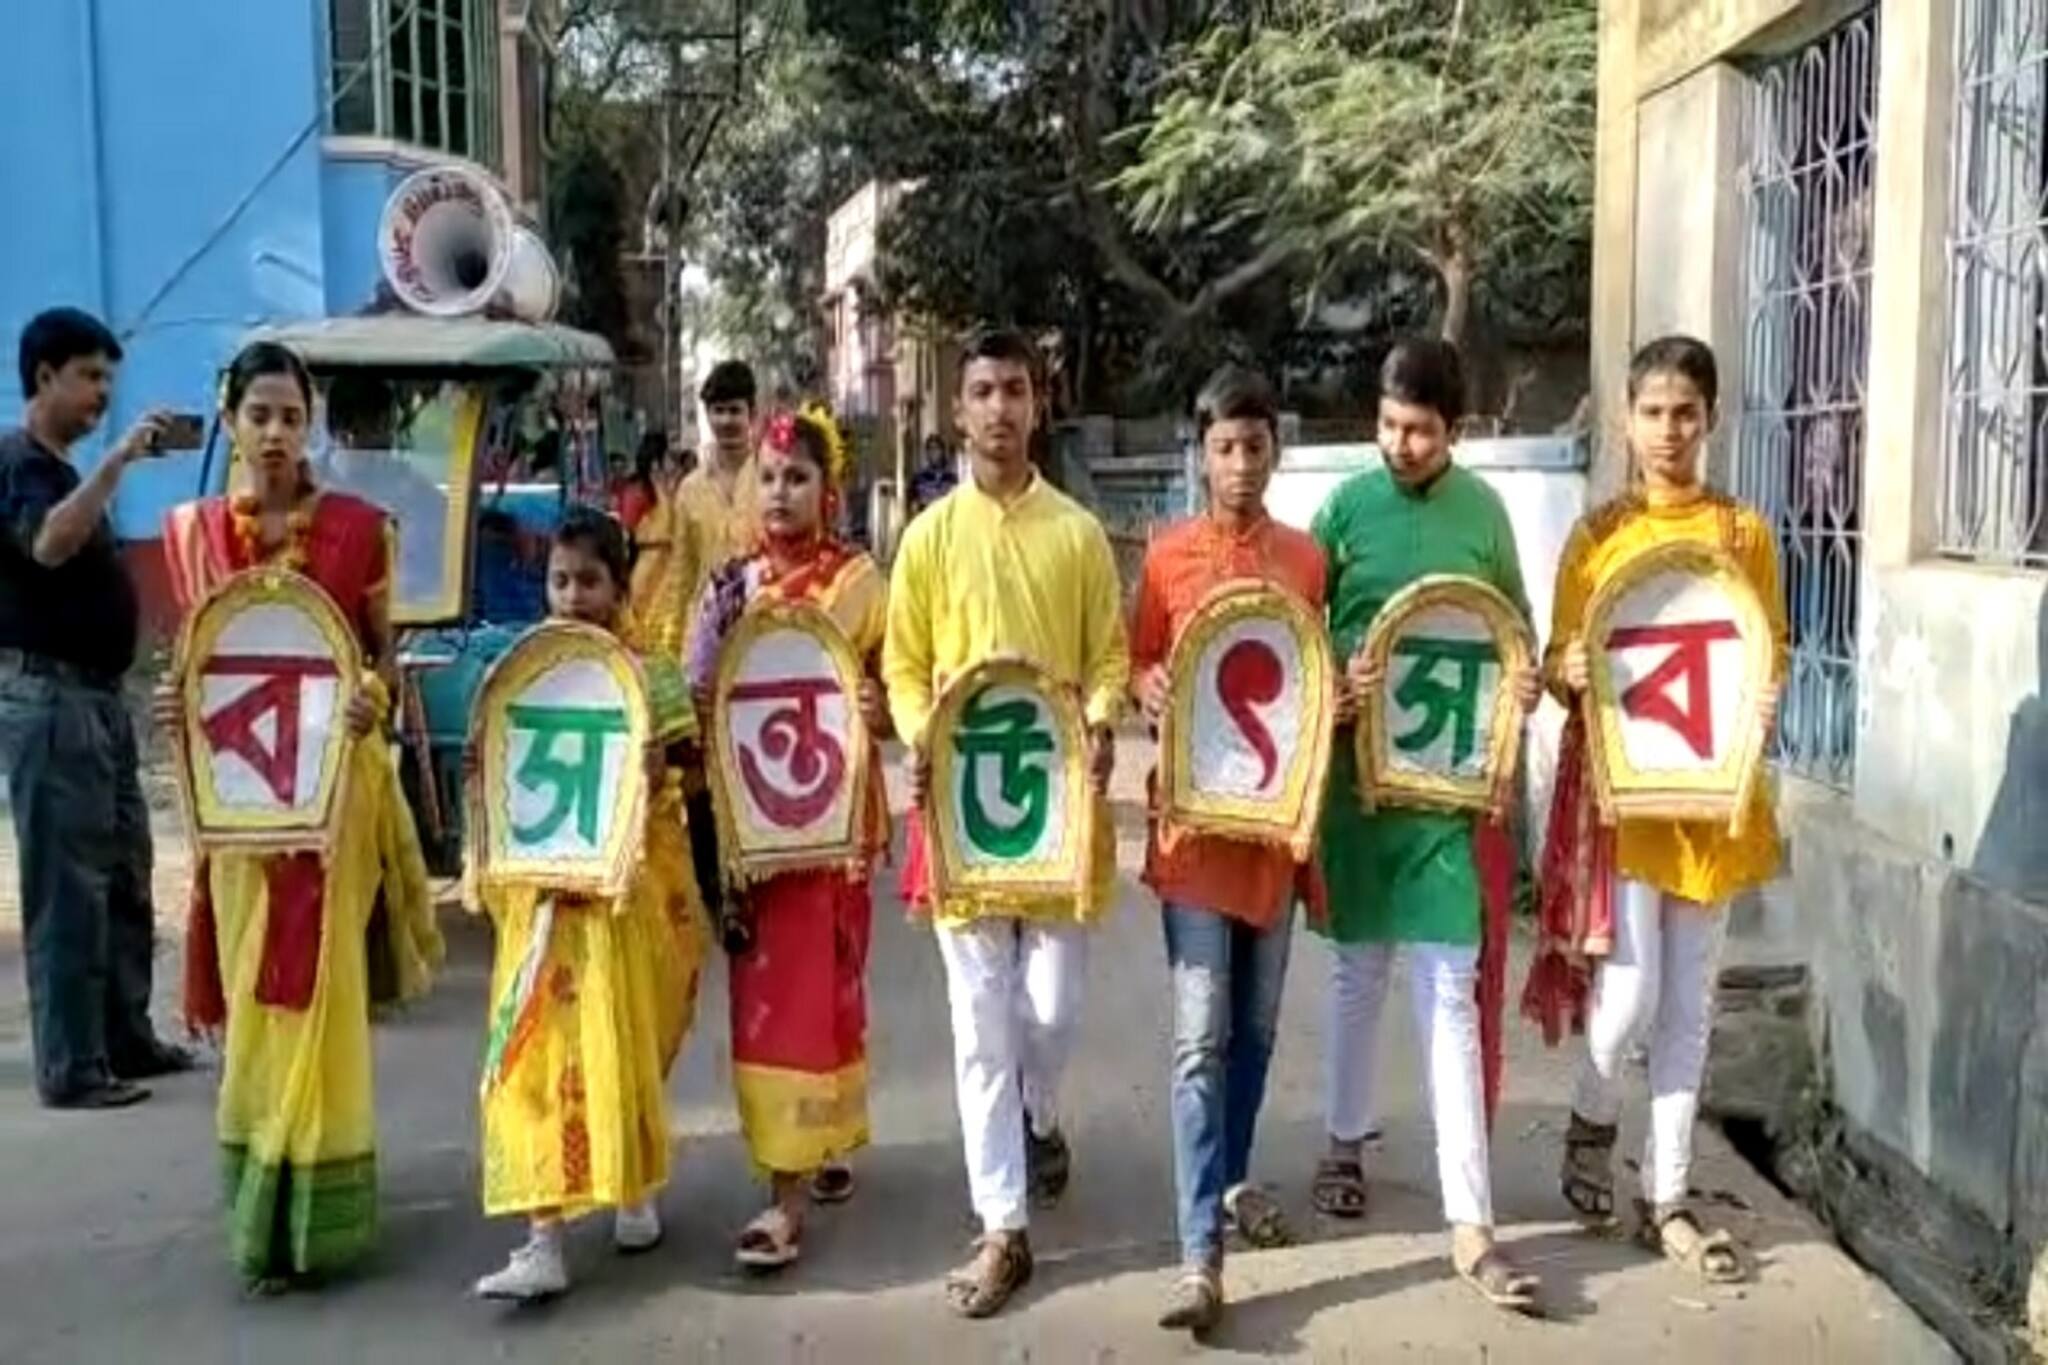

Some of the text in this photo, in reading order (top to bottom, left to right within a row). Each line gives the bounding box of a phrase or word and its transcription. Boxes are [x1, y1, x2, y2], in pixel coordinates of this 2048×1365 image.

[201, 656, 339, 806] ব
[1216, 639, 1283, 791] ৎ
[1393, 637, 1500, 766] স
[1607, 620, 1740, 759] ব
[505, 705, 630, 847] স
[953, 685, 1055, 857] উ
